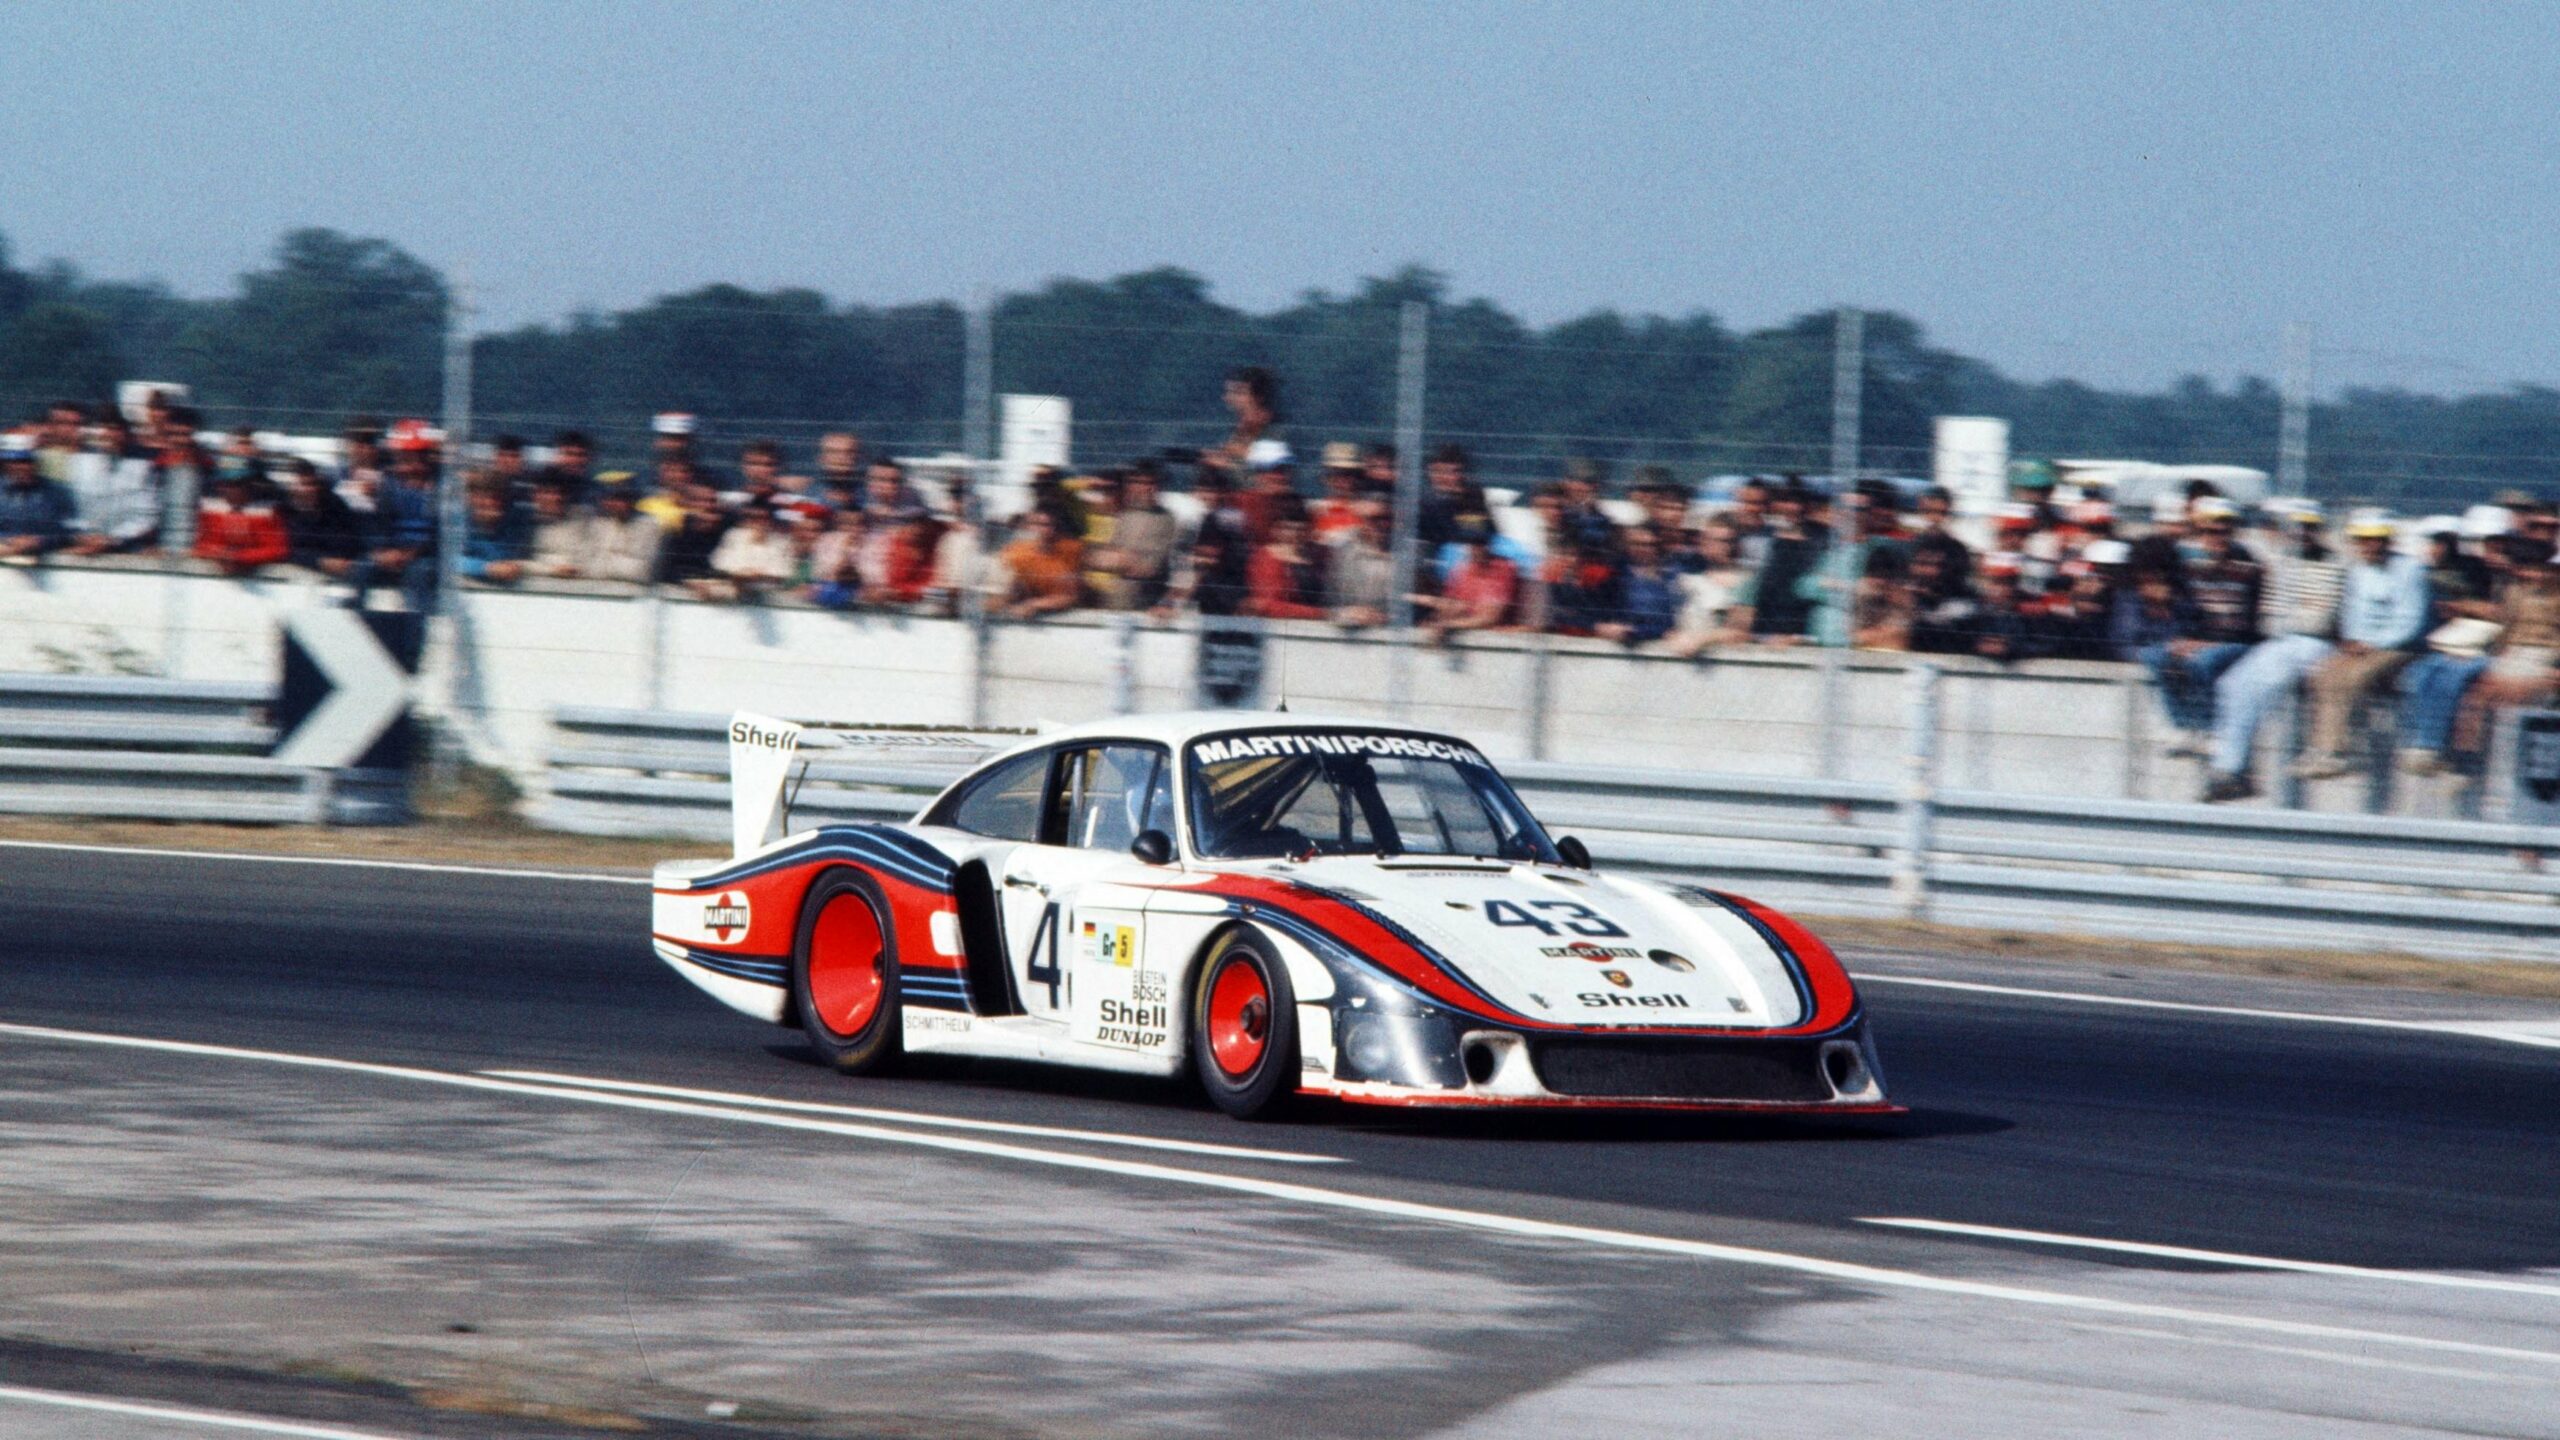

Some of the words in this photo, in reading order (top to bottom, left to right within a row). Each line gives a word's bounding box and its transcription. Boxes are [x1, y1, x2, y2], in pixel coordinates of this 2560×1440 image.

[732, 721, 798, 750] Shell
[704, 906, 748, 928] MARTINI
[1484, 900, 1631, 937] 43
[1102, 932, 1116, 957] Gr
[1120, 933, 1128, 959] 5
[1541, 947, 1643, 959] MARTINI
[1132, 985, 1167, 1003] BOSCH
[1577, 993, 1690, 1008] Shell
[1100, 998, 1167, 1028] Shell
[1097, 1026, 1167, 1047] DUNLOP
